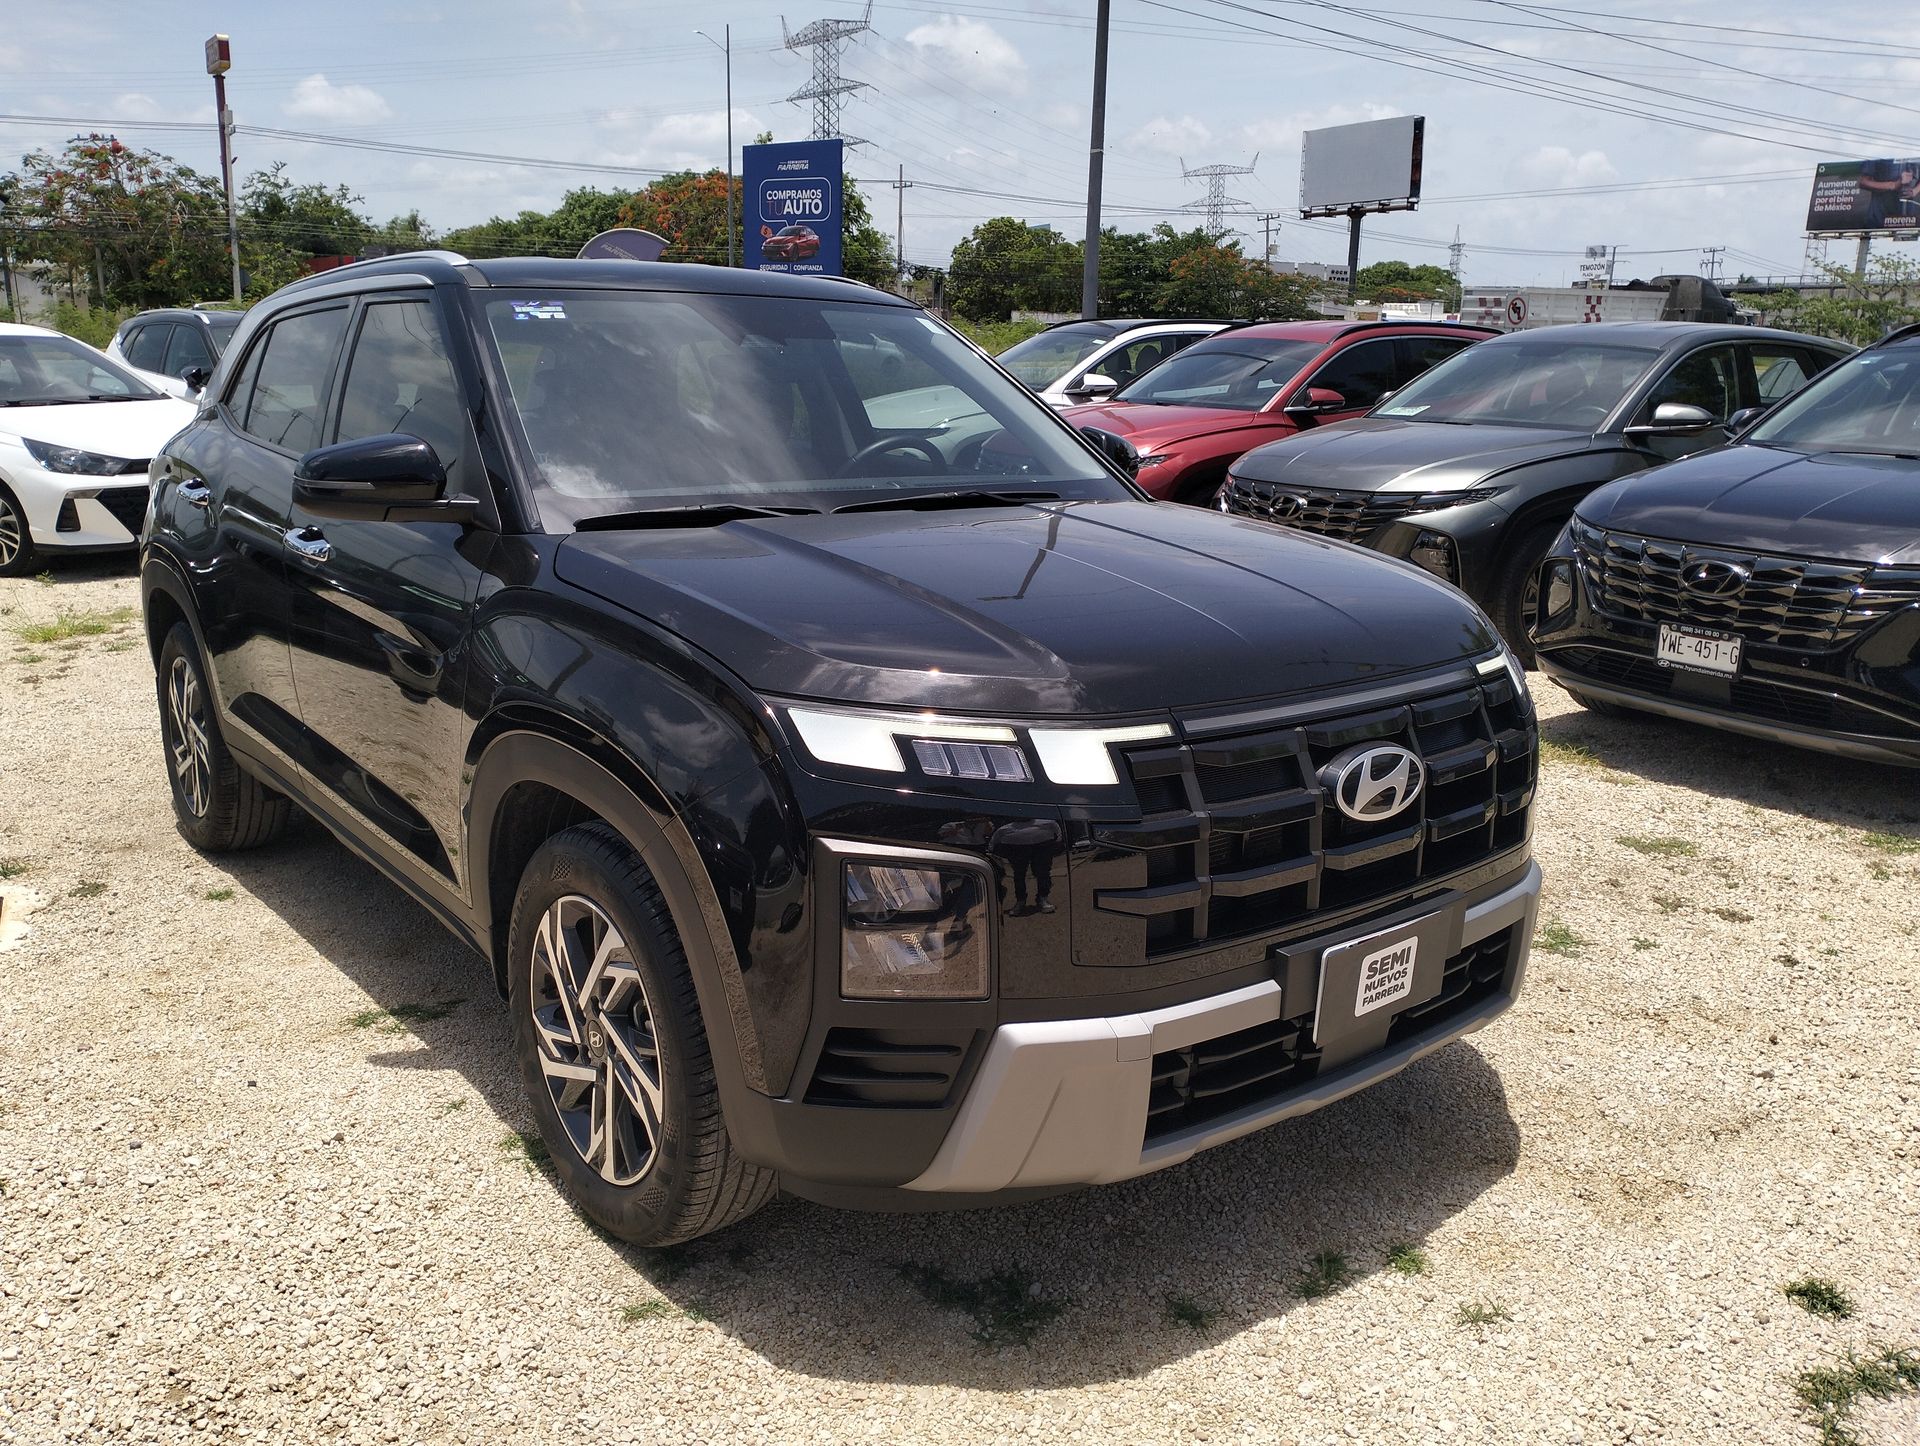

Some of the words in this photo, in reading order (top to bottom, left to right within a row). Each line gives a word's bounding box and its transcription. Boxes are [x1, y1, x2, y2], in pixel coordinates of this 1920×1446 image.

[1818, 180, 1857, 189] Aumentar
[766, 189, 822, 200] COMPRAMOS
[1824, 188, 1850, 196] salario
[1814, 197, 1828, 206] por
[1837, 195, 1854, 203] bien
[767, 200, 783, 216] TU
[783, 198, 823, 215] AUTO
[1814, 204, 1824, 212] de
[1884, 216, 1917, 224] morena
[759, 264, 789, 272] SEGURIDAD
[793, 264, 824, 272] CONFIANZA
[1661, 633, 1739, 665] YWE-451-G
[1670, 662, 1733, 679] www.hyundaimerida.mx
[1366, 946, 1412, 980] SEMI
[1364, 967, 1408, 994] NUEVOS
[1362, 981, 1406, 1007] FARRERA
